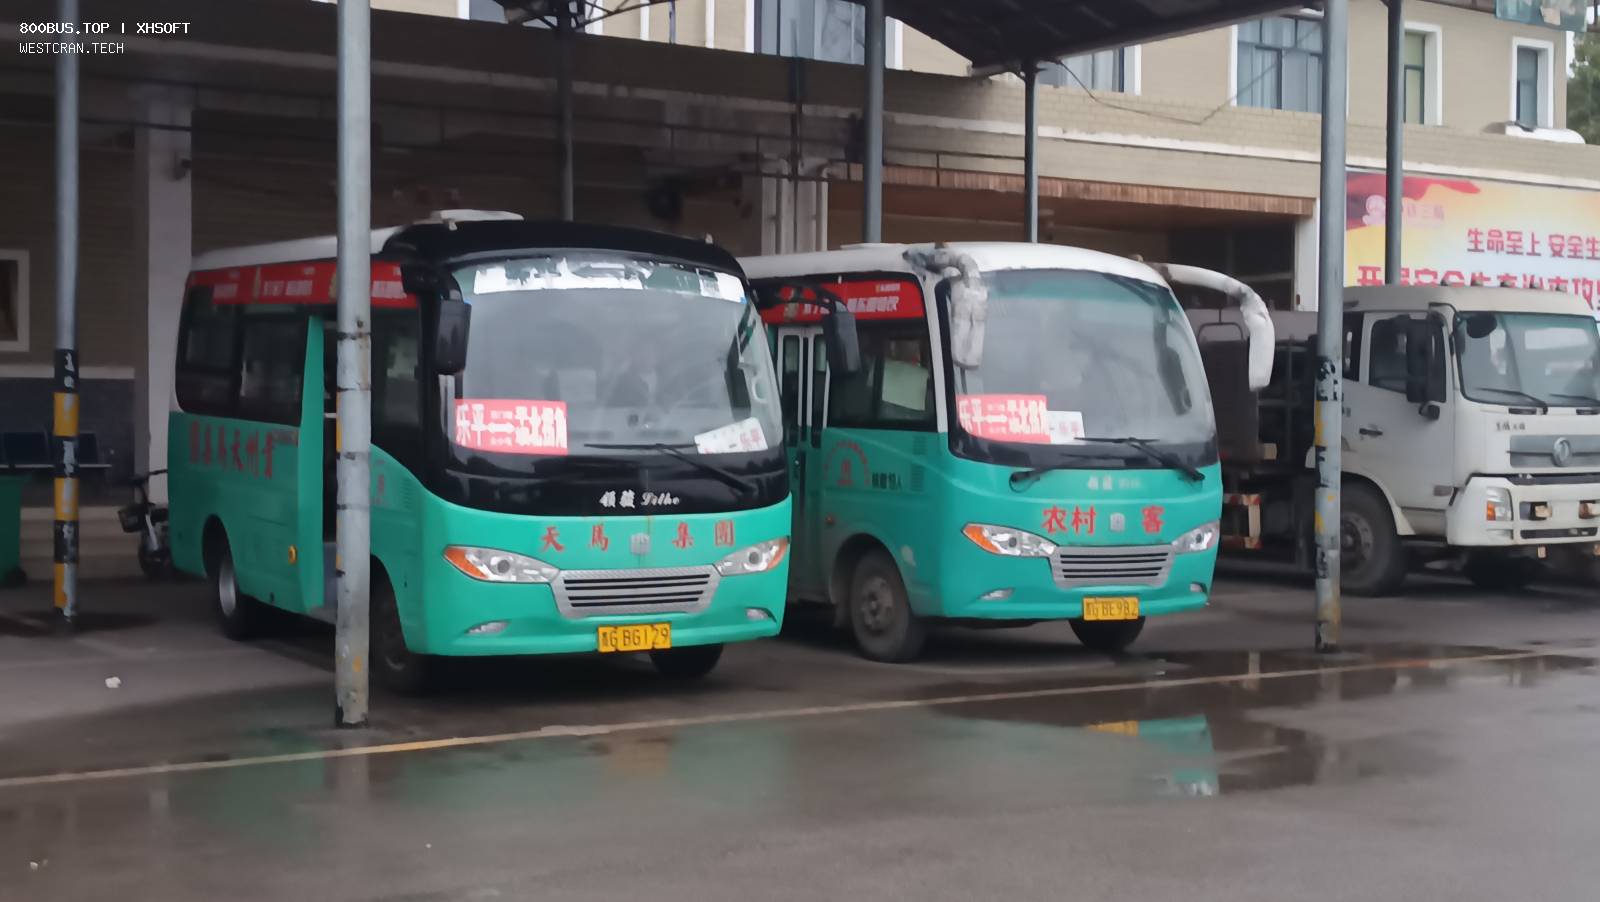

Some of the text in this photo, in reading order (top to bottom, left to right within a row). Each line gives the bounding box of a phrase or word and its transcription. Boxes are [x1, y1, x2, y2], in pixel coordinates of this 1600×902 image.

[1467, 227, 1542, 256] 生命至上
[456, 403, 487, 447] 乐平
[1041, 504, 1166, 534] 农村 客
